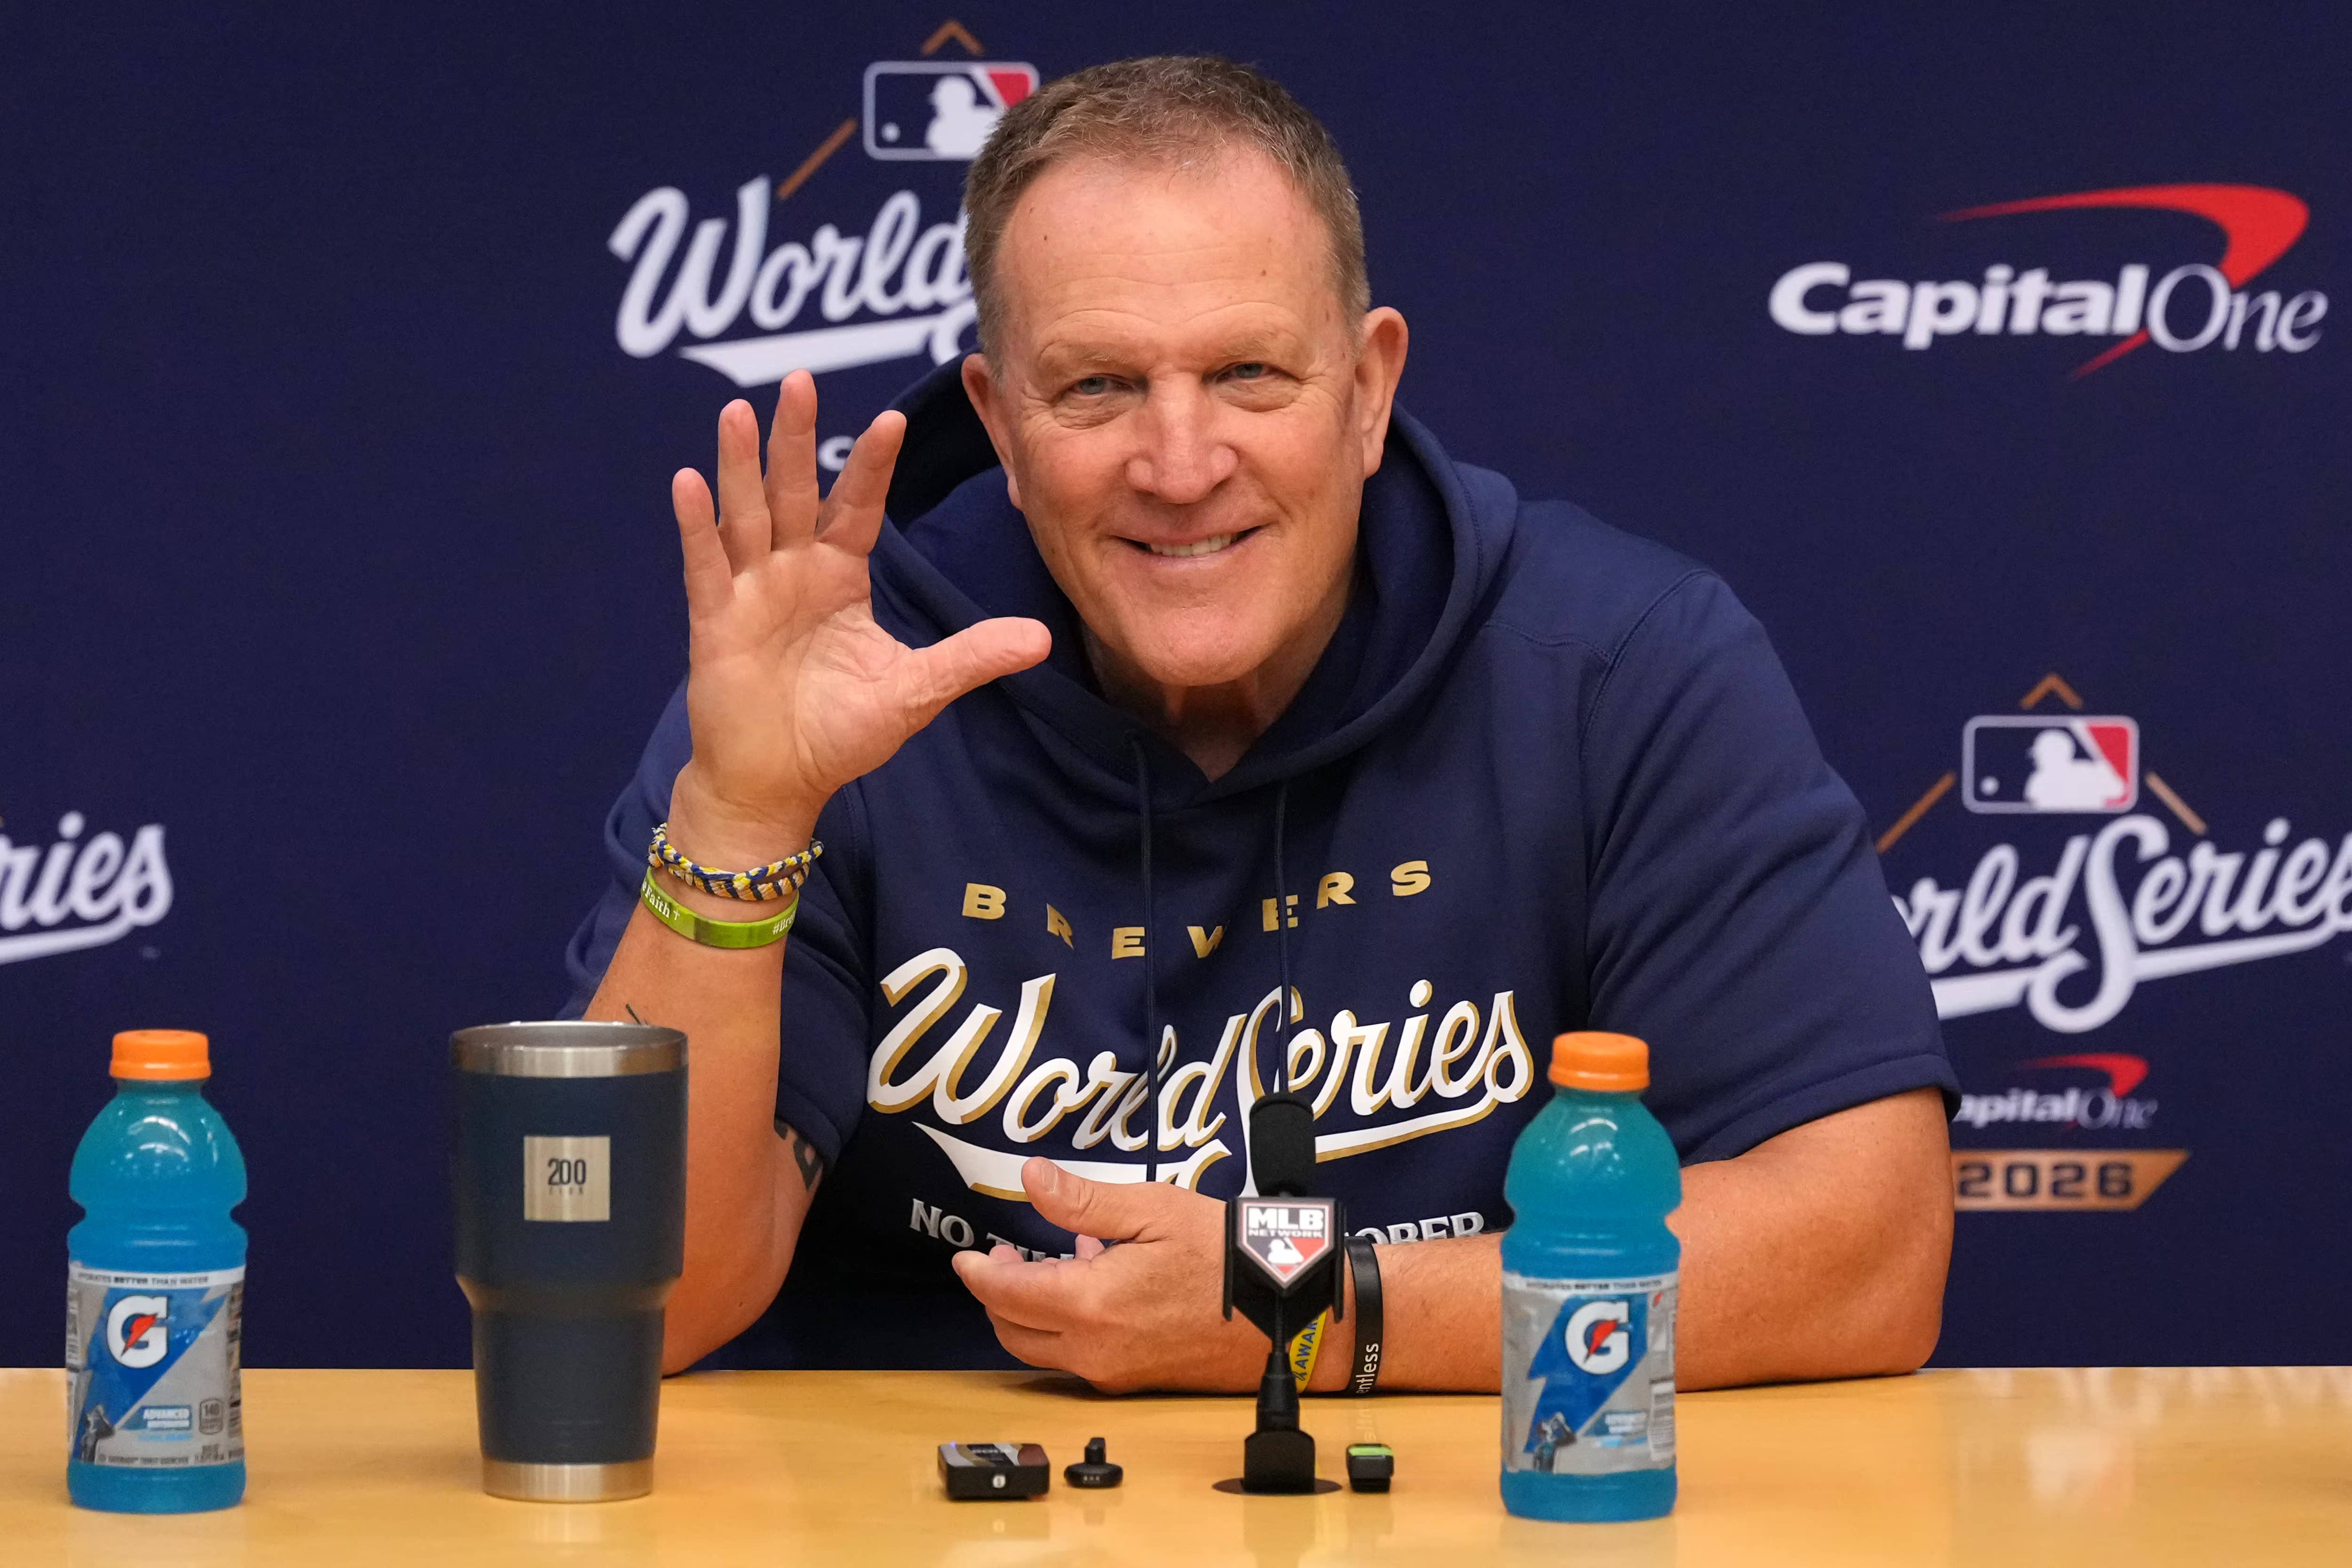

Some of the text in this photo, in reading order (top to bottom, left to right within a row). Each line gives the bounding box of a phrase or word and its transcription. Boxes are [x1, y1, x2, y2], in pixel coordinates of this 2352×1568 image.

[0, 810, 174, 931] ries
[644, 884, 670, 919] Faith
[1890, 836, 2092, 974] rld
[866, 947, 1534, 1197] World Series
[548, 1158, 586, 1186] 200
[1958, 1160, 2133, 1198] 2026
[909, 1198, 974, 1248] NO
[1248, 1207, 1324, 1231] MLB
[1248, 1229, 1323, 1239] NETWORK
[1355, 1343, 1379, 1393] entless
